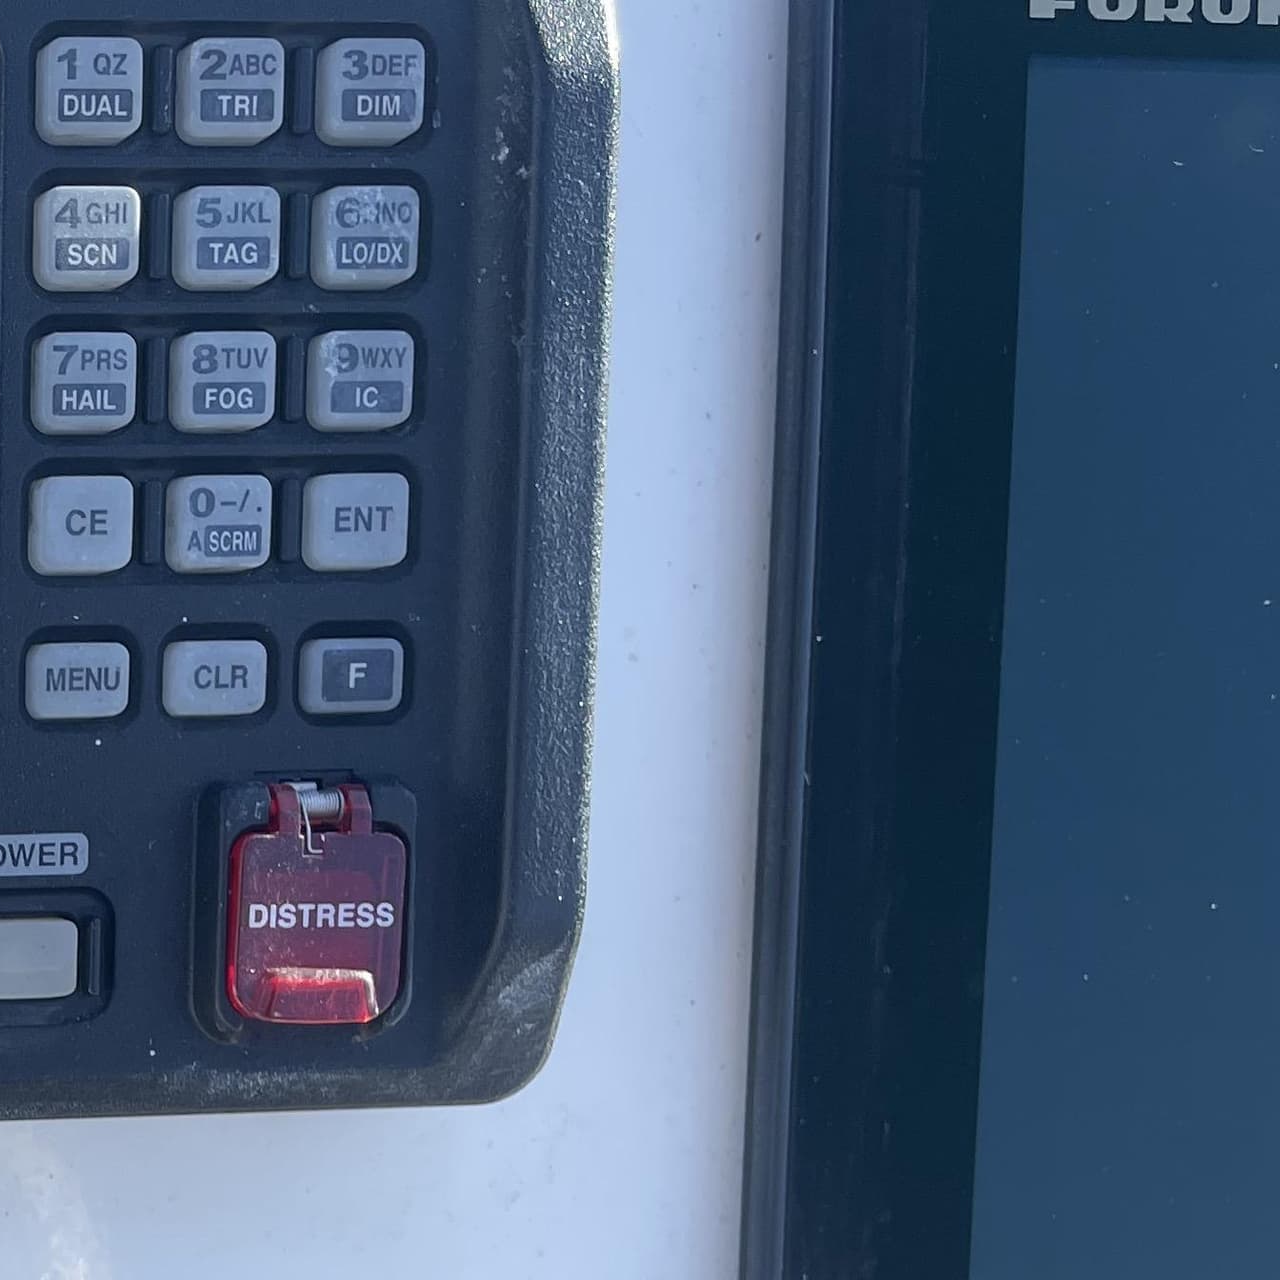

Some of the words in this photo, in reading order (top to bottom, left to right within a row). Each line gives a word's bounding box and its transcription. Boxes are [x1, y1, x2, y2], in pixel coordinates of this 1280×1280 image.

[63, 95, 127, 117] DUAL
[218, 95, 258, 117] TRI
[356, 95, 401, 117] DIM
[67, 242, 117, 266] SCN
[209, 242, 258, 265] TAG
[341, 242, 403, 265] LO/DX
[61, 389, 116, 411] HAIL
[205, 387, 254, 409] FOG
[355, 386, 380, 408] IC
[65, 508, 108, 536] CE
[334, 505, 393, 533] ENT
[208, 530, 257, 552] SCRM
[45, 666, 120, 693] MENU
[193, 664, 248, 690] CLR
[349, 662, 368, 689] F
[247, 901, 395, 930] DISTRESS
